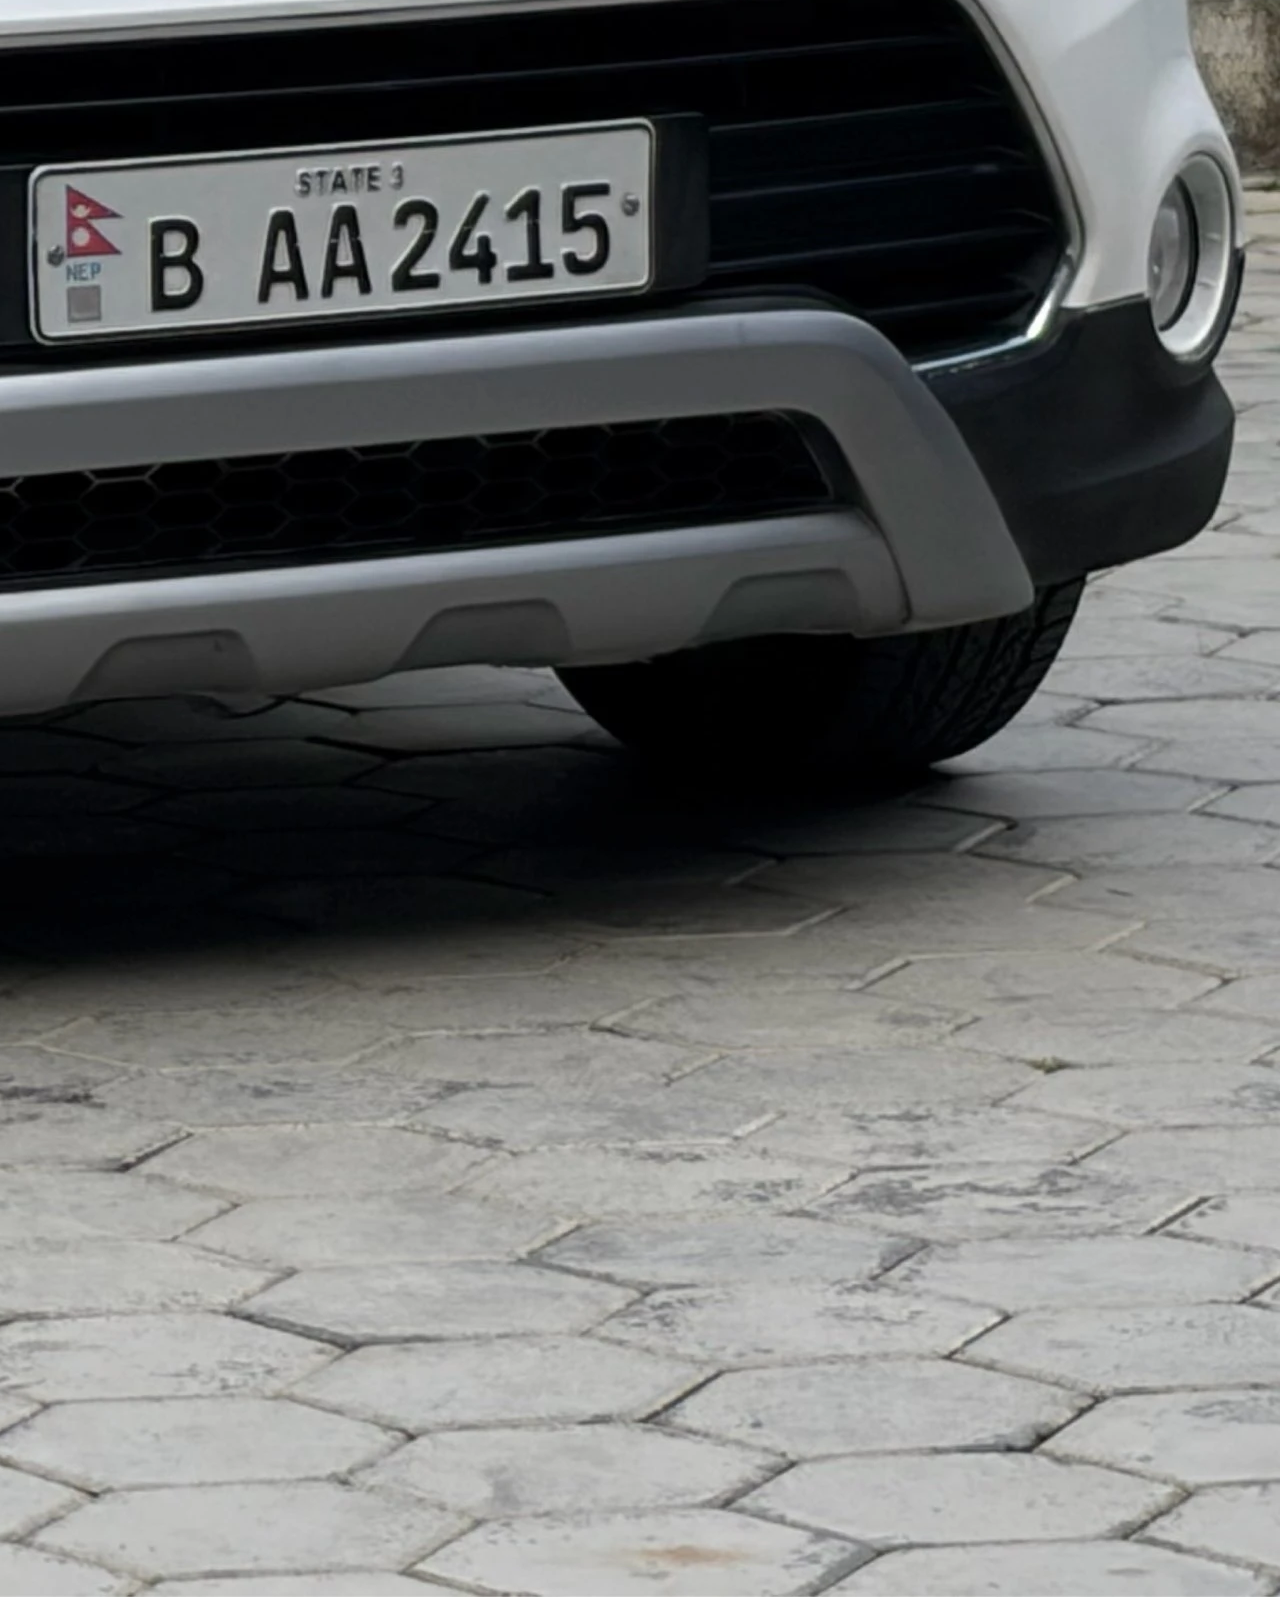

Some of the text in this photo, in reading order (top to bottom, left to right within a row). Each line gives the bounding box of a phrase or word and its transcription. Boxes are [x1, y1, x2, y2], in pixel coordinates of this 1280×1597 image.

[294, 161, 406, 196] STATE 3
[148, 181, 612, 313] B AA2415
[65, 261, 103, 282] NEP
